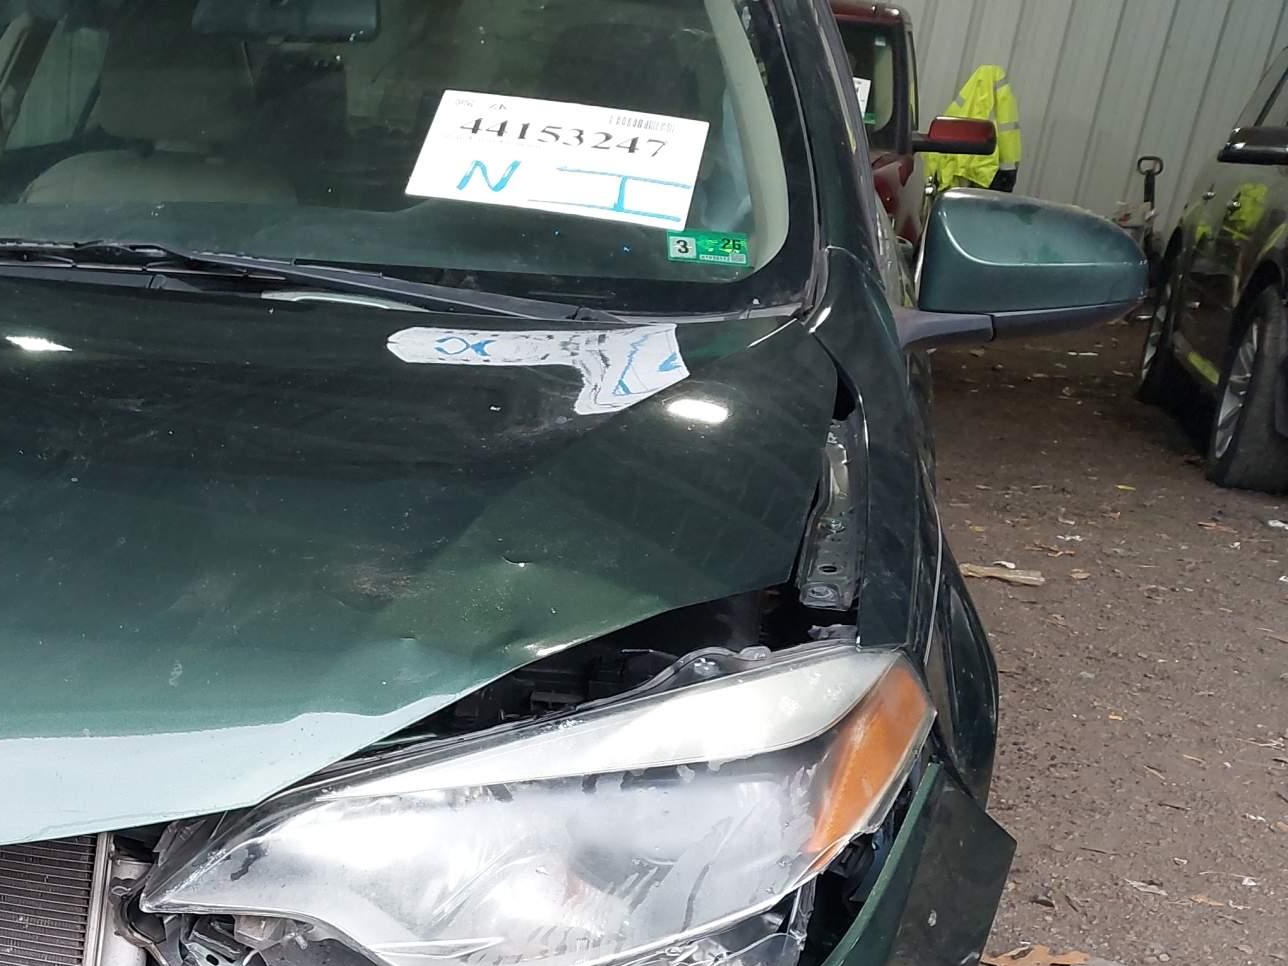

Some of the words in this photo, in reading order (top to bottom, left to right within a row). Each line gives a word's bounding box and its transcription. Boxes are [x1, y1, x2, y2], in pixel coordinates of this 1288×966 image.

[459, 116, 668, 157] 44153247
[456, 160, 521, 192] N
[676, 239, 690, 254] 3
